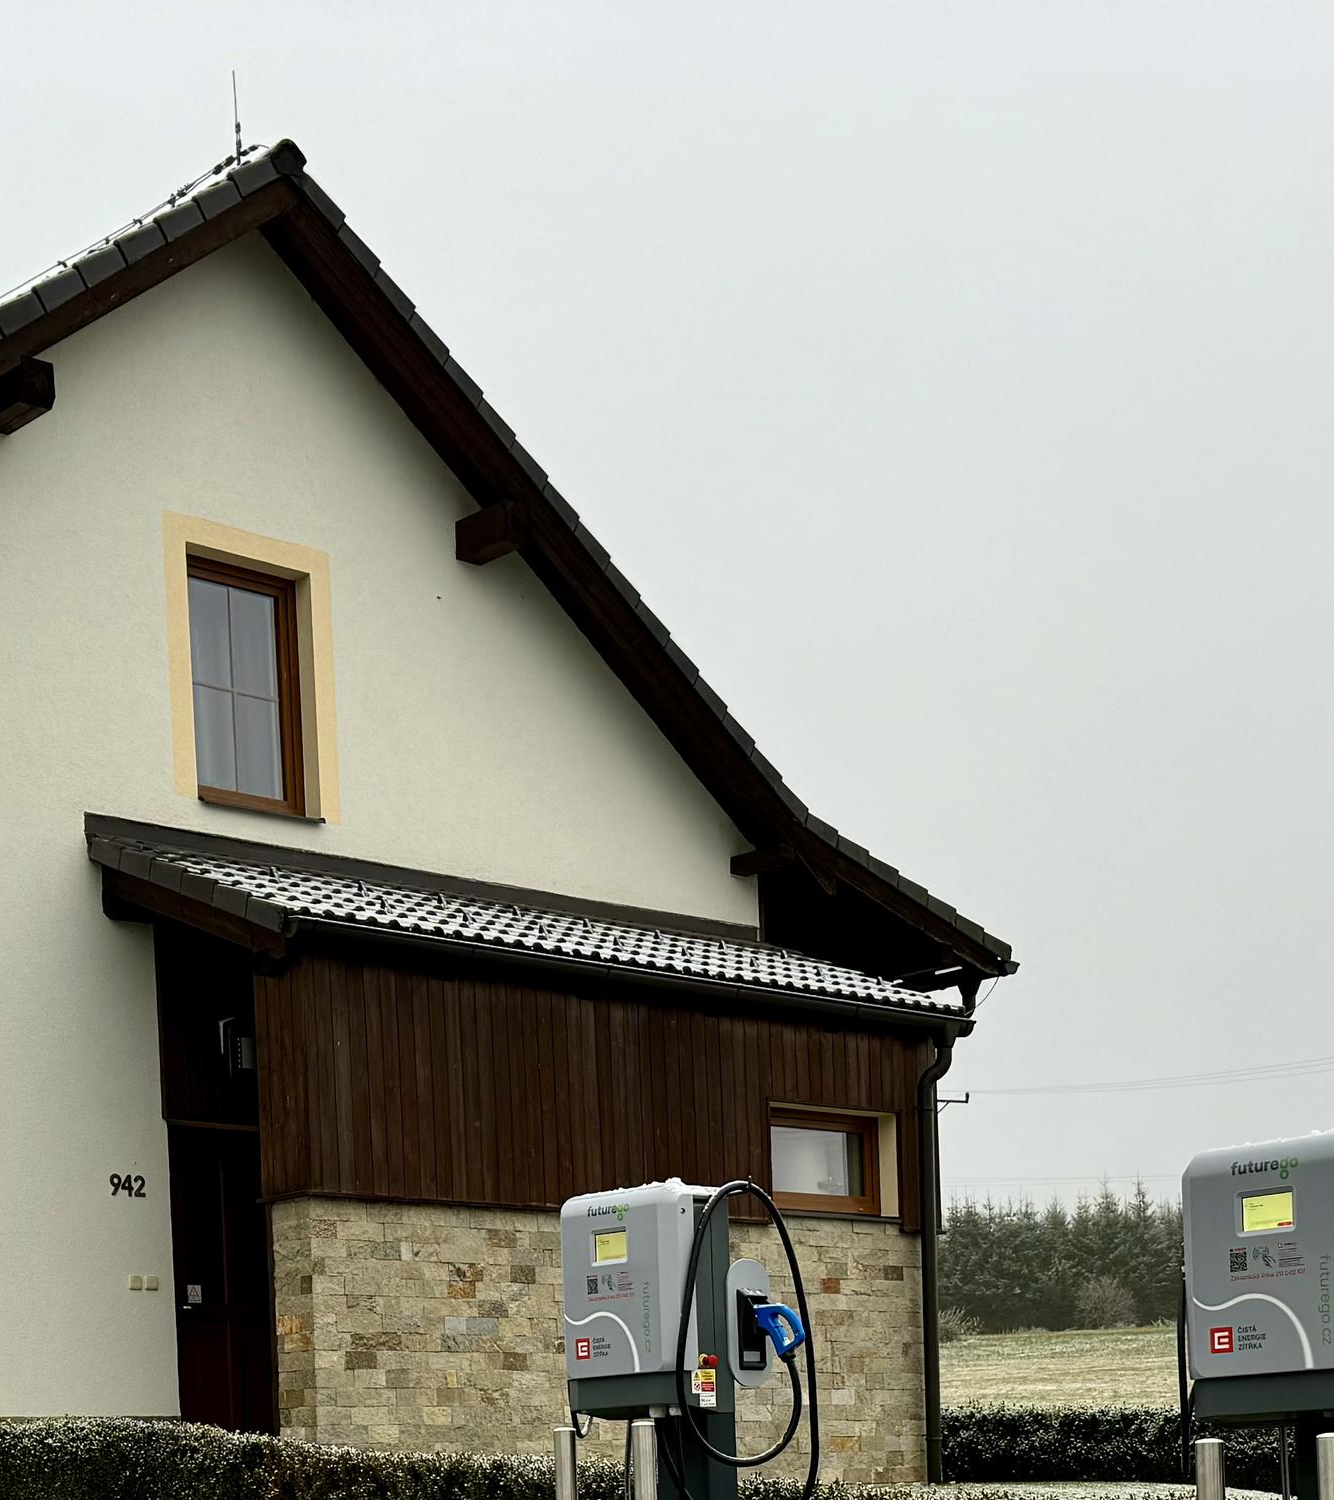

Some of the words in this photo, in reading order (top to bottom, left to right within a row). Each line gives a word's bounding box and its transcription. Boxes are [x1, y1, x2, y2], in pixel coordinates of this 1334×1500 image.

[1230, 1157, 1298, 1180] futurego
[109, 1173, 146, 1198] 942
[587, 1203, 629, 1221] futurego
